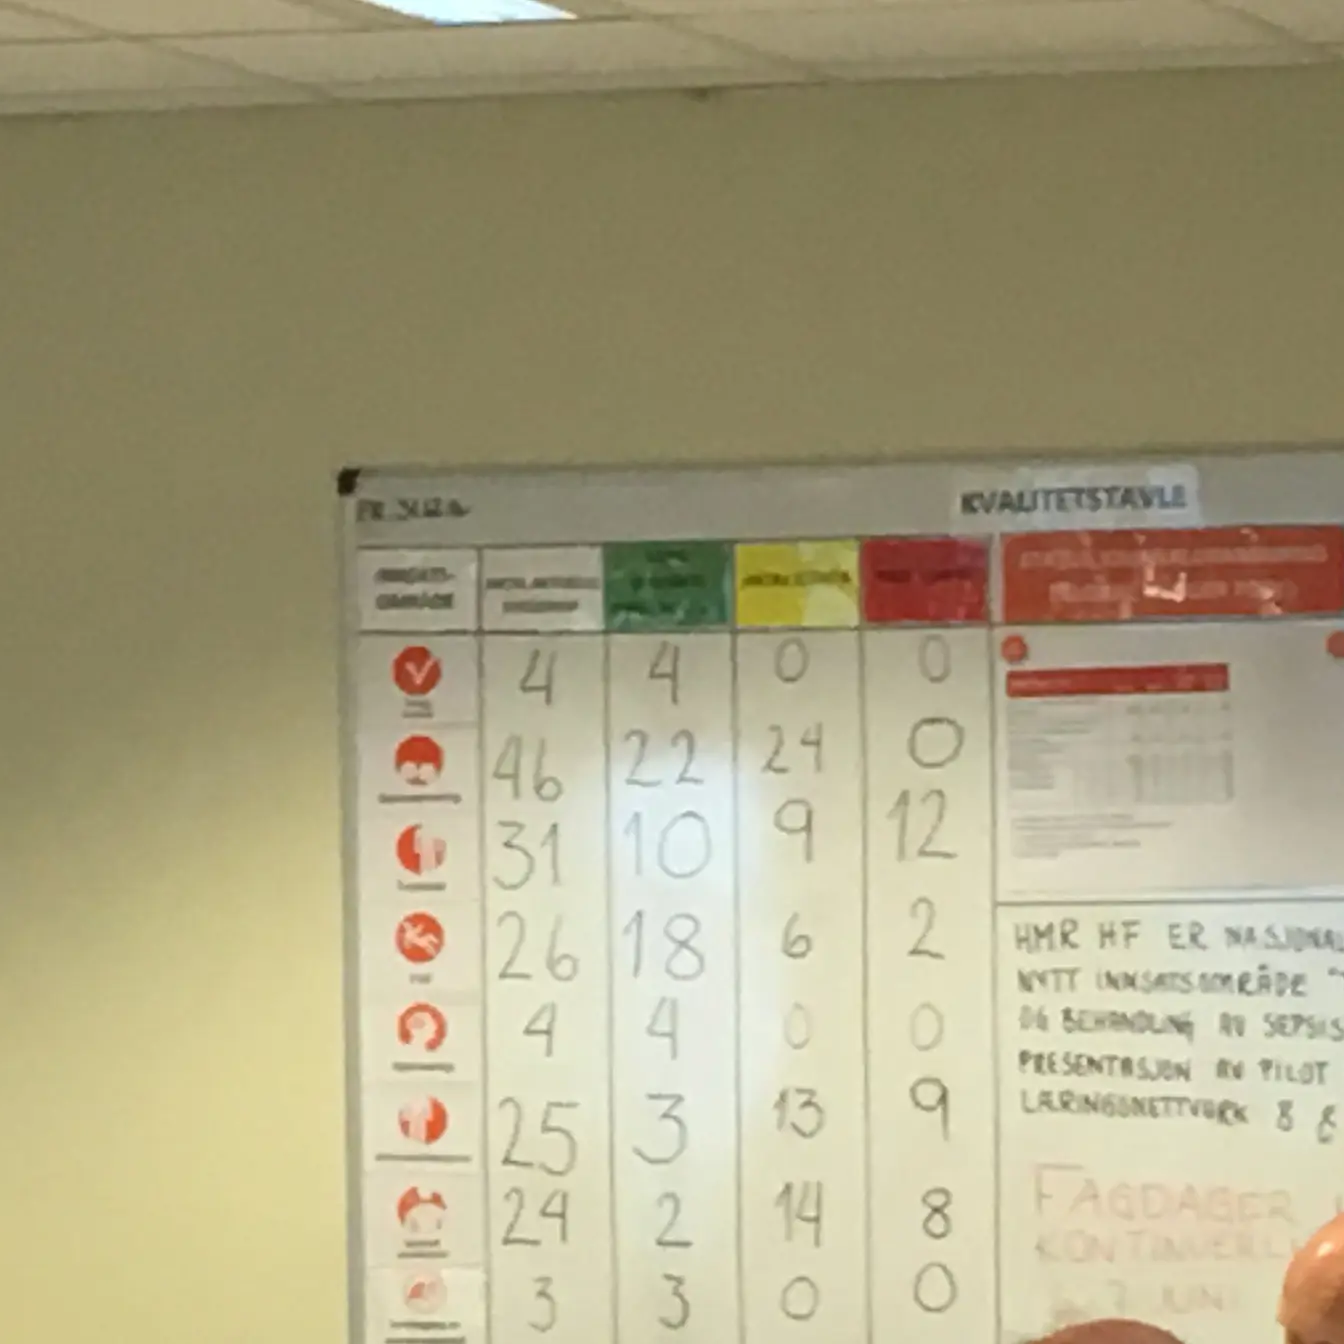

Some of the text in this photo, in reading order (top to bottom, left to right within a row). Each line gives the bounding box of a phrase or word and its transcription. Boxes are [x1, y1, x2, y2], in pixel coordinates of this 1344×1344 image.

[960, 484, 1189, 516] KVALITETSTAVLE
[520, 635, 952, 703] 4 4 0 0
[492, 734, 562, 802] 46
[624, 729, 704, 787] 22
[761, 722, 824, 773] 24
[909, 717, 966, 769] 0
[492, 821, 560, 889] 31
[624, 810, 711, 878] 10
[773, 798, 815, 862] 9
[887, 790, 957, 860] 12
[498, 896, 945, 983] 26 18 6 2
[1015, 918, 1080, 953] HMR
[1098, 919, 1141, 950] HF
[1168, 921, 1208, 950] ER
[1017, 967, 1081, 993] NYTT
[523, 996, 944, 1060] 4 4 0 0
[1017, 1004, 1050, 1032] OG
[1061, 1007, 1195, 1044] BEHANDLING
[1219, 1012, 1246, 1037] AV
[1017, 1050, 1192, 1081] PRESENTASJON
[1216, 1058, 1244, 1080] AV
[1258, 1058, 1329, 1085] PILOT
[498, 1075, 951, 1176] 25 3 13 9
[1275, 1099, 1295, 1132] 8
[502, 1179, 953, 1248] 24 2 14 8
[1035, 1162, 1296, 1224] FAGDAGER
[528, 1262, 956, 1333] 3 3 0 0
